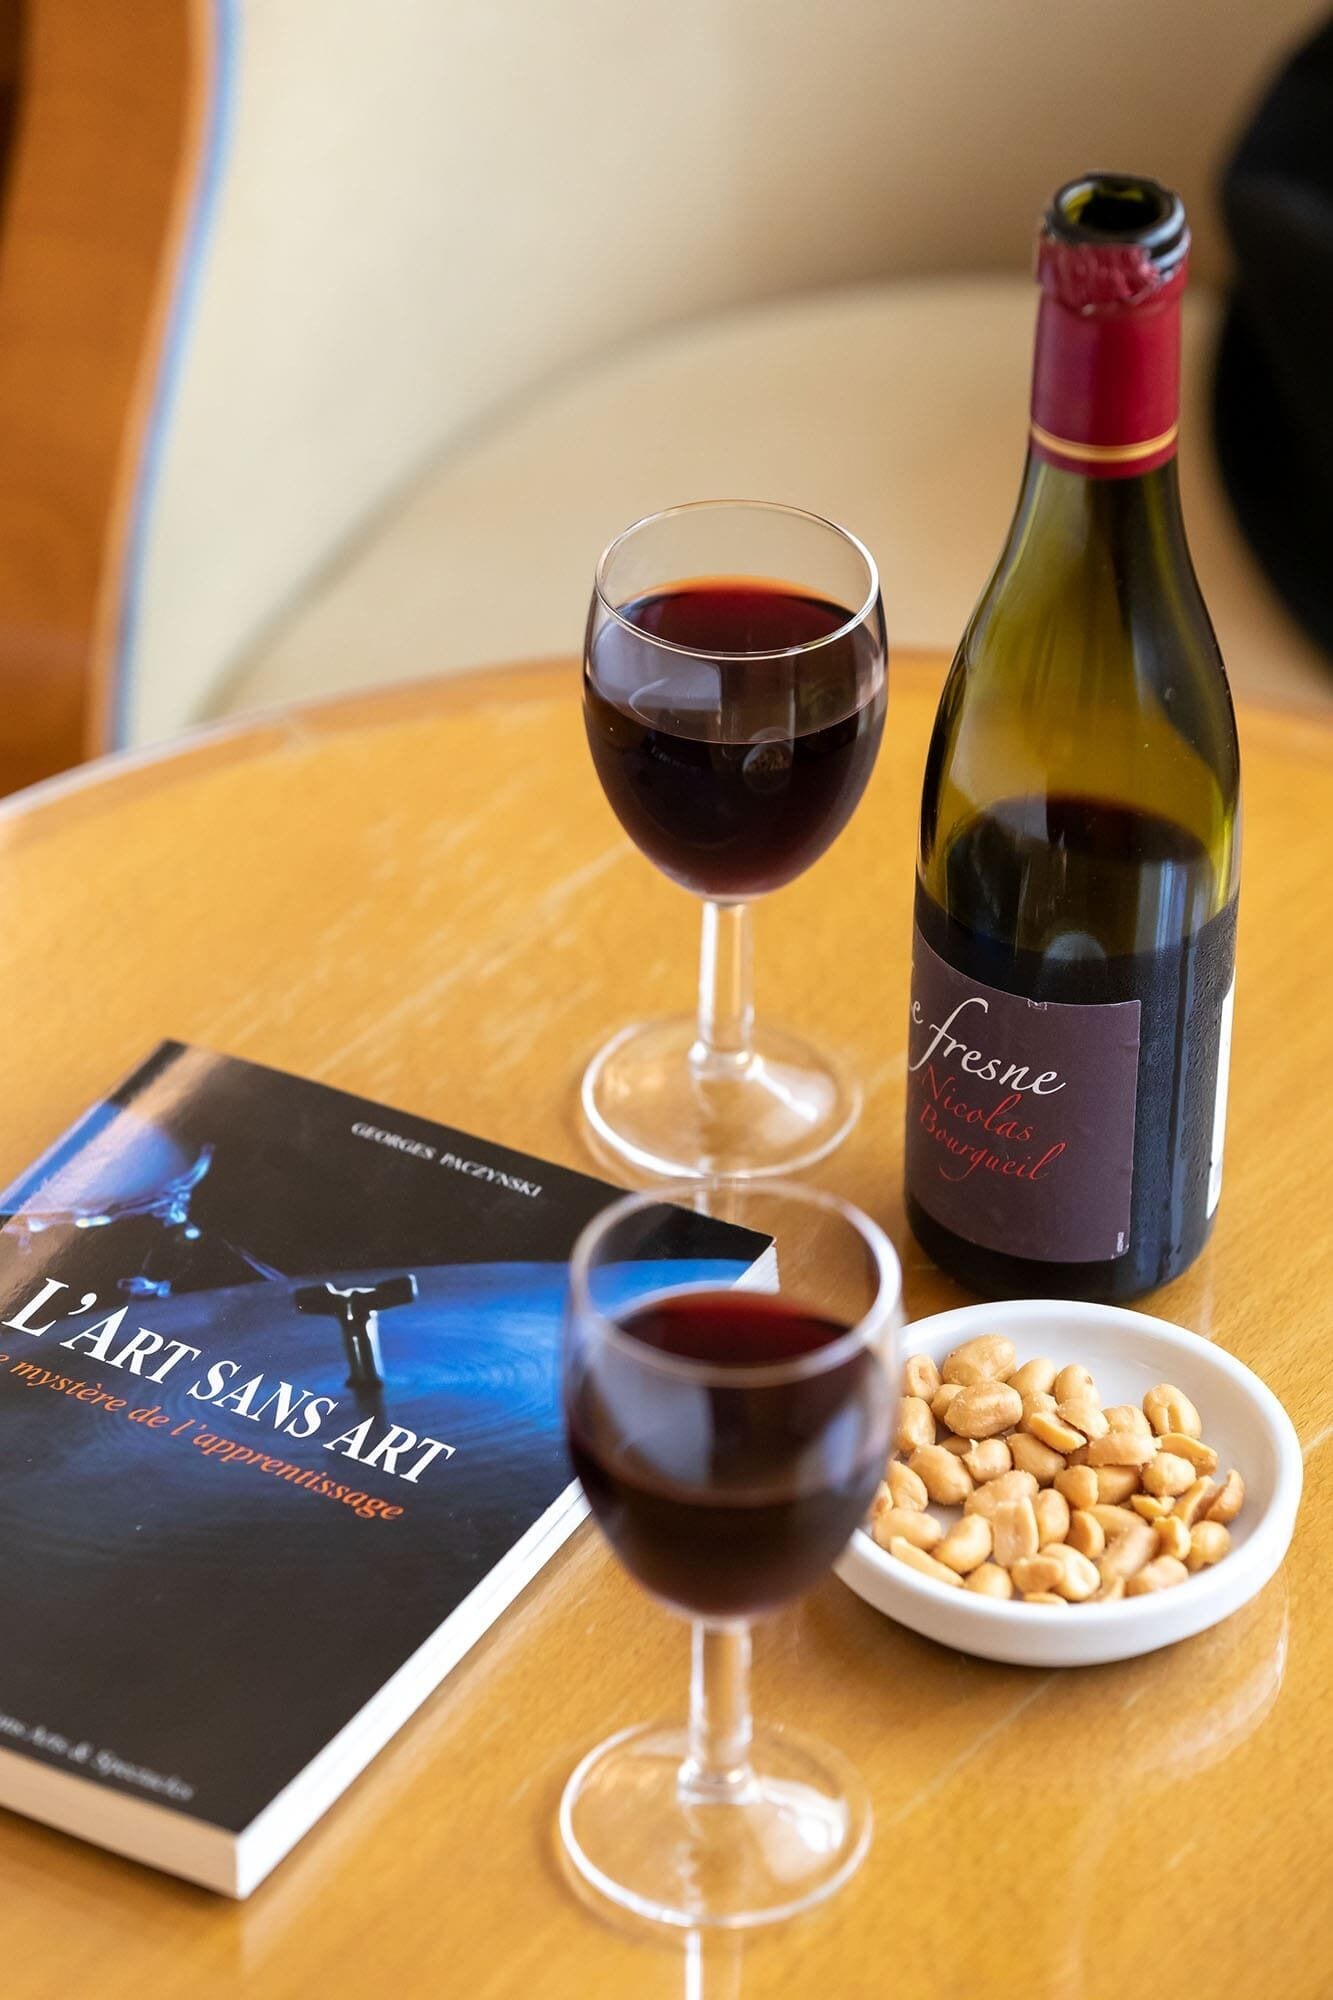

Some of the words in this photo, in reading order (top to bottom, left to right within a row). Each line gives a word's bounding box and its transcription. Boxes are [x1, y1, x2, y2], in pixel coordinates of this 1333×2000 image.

[908, 997, 1067, 1095] fresne
[918, 1103, 1067, 1182] Bourgueil
[920, 1064, 1035, 1143] Nicolas
[351, 1121, 437, 1160] GEORGES
[439, 1152, 543, 1198] PACZYNSKI
[1, 1277, 202, 1385] L'ART
[186, 1360, 339, 1438] SANS
[322, 1415, 456, 1484] ART
[9, 1360, 128, 1412] mystère
[128, 1405, 170, 1429] de
[169, 1418, 405, 1521] l'apprentissage
